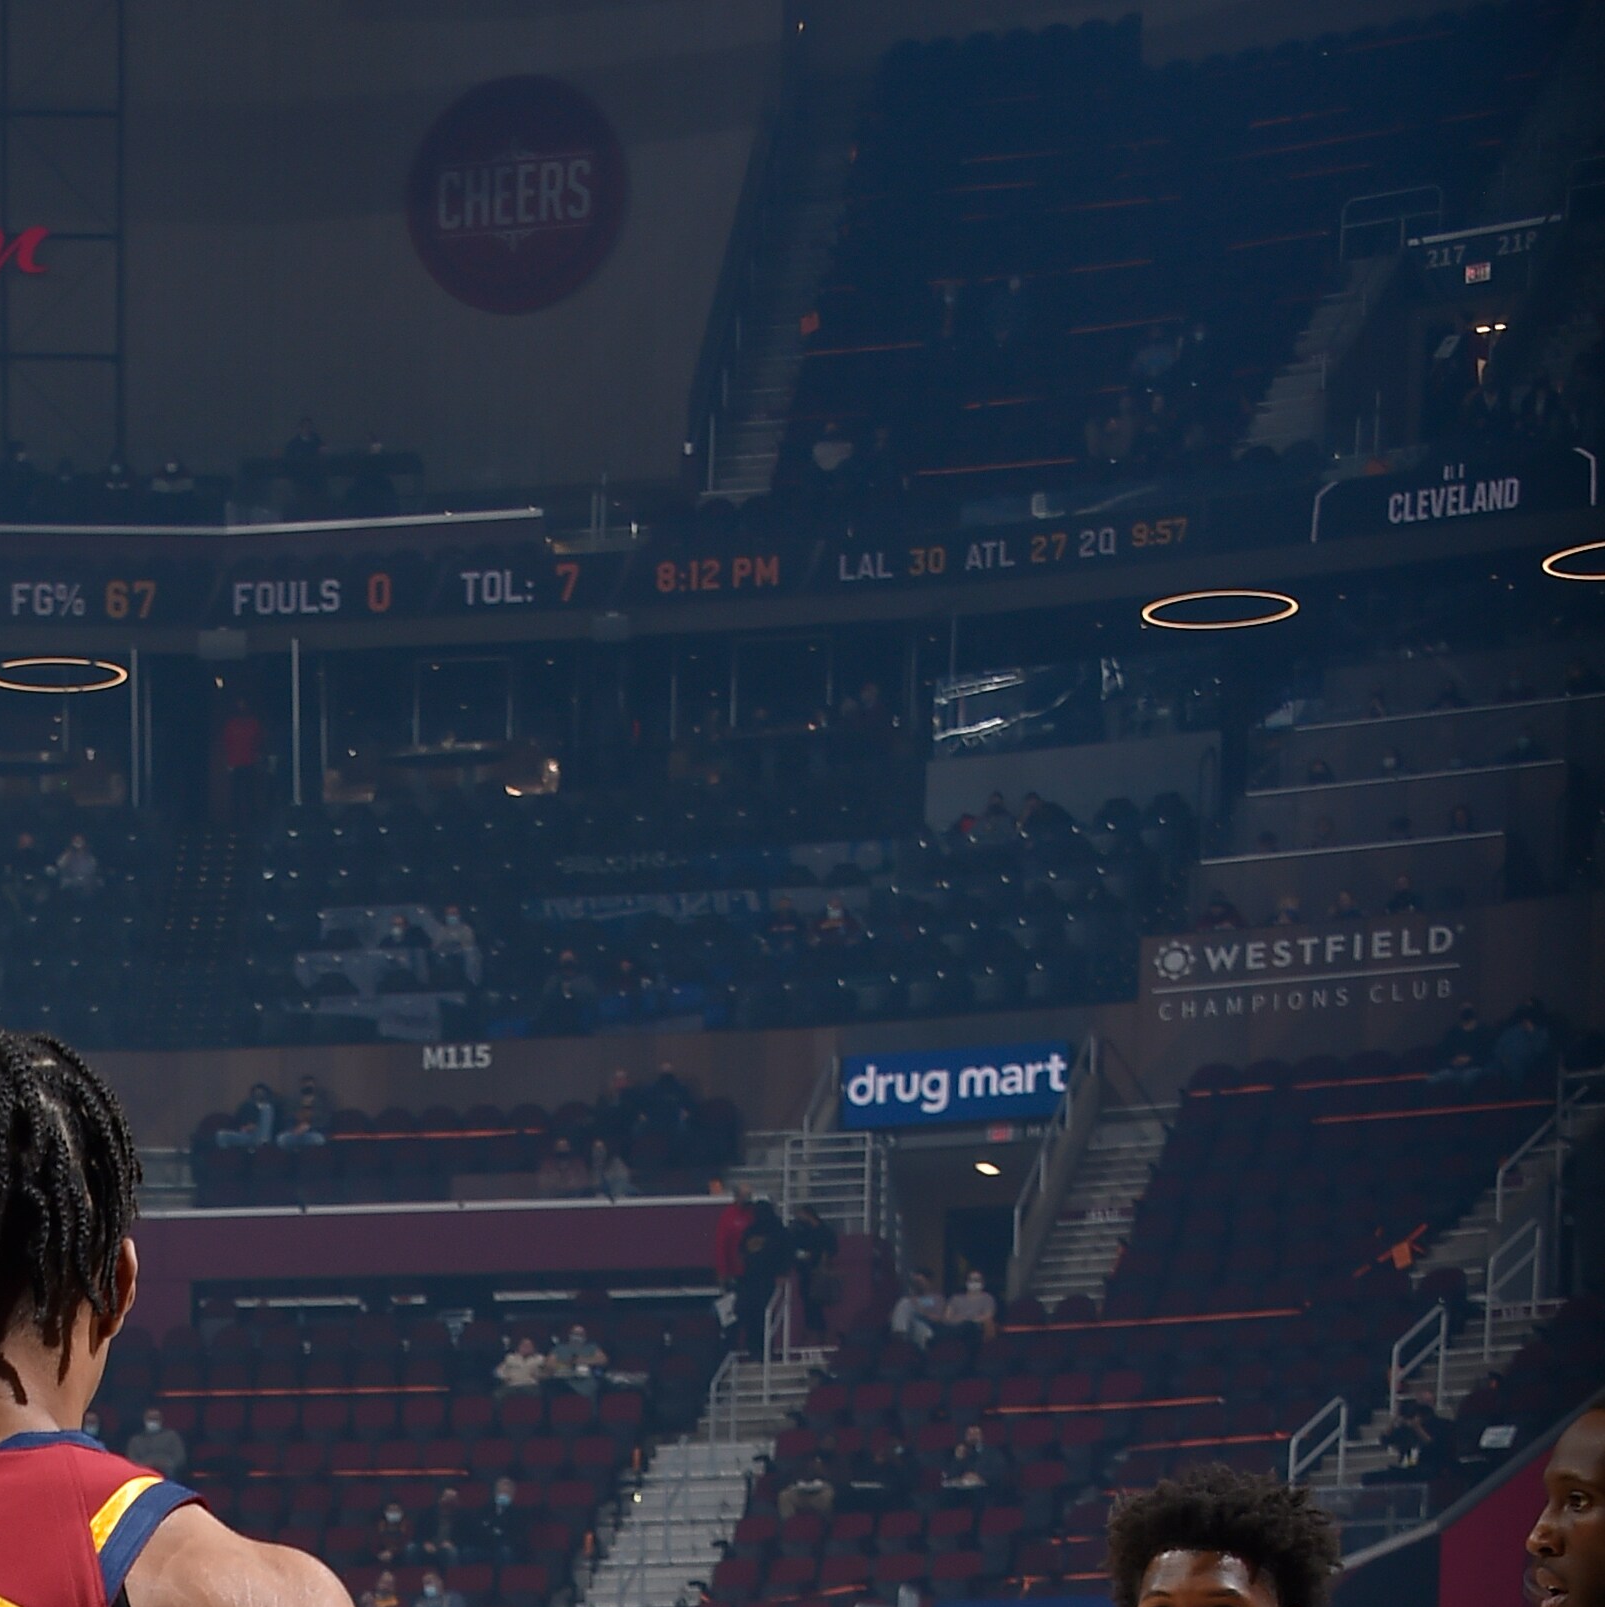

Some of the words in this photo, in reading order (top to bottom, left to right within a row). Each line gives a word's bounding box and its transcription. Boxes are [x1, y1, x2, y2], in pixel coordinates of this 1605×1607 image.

[436, 158, 593, 231] CHEERS
[1387, 476, 1521, 525] CLEVELAND
[837, 552, 894, 582] LAL
[907, 546, 947, 577] 30
[964, 541, 1016, 571] ATL
[1030, 533, 1066, 563] 27
[1077, 529, 1117, 560] 2Q
[1130, 516, 1188, 549] 9:57
[232, 577, 343, 618] FOULS
[367, 573, 392, 613] 0
[460, 568, 536, 606] TOL:
[554, 563, 580, 602] 7
[656, 558, 722, 594] 8:12
[732, 555, 780, 587] PM
[9, 581, 87, 618] FG%
[104, 580, 158, 619] 67
[1202, 924, 1456, 974] WESTFIELD
[1158, 986, 1351, 1022] CHAMPIONS
[1369, 978, 1454, 1004] CLUB
[420, 1042, 494, 1071] M115
[847, 1063, 953, 1115] drug
[957, 1051, 1069, 1100] mart
